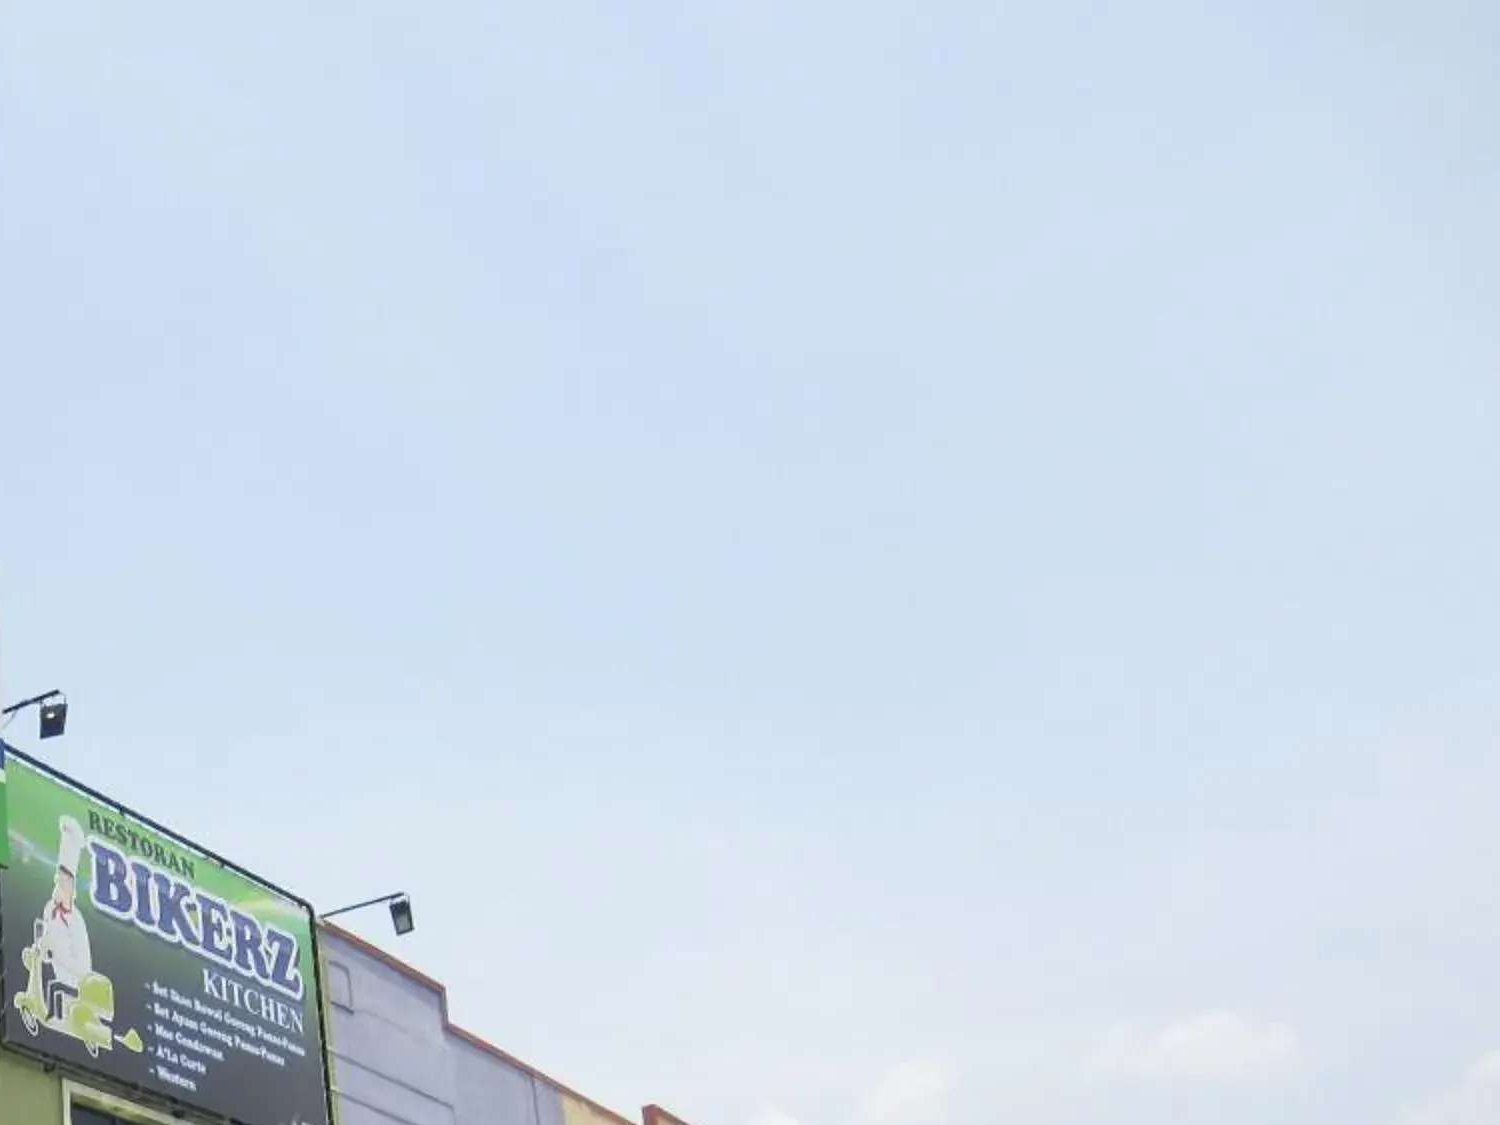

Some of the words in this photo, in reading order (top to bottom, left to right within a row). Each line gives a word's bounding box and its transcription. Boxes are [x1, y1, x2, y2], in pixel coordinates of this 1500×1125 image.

[88, 809, 195, 880] RESTORAN
[88, 836, 303, 1000] BIKERZ
[203, 968, 304, 1036] KITCHEN
